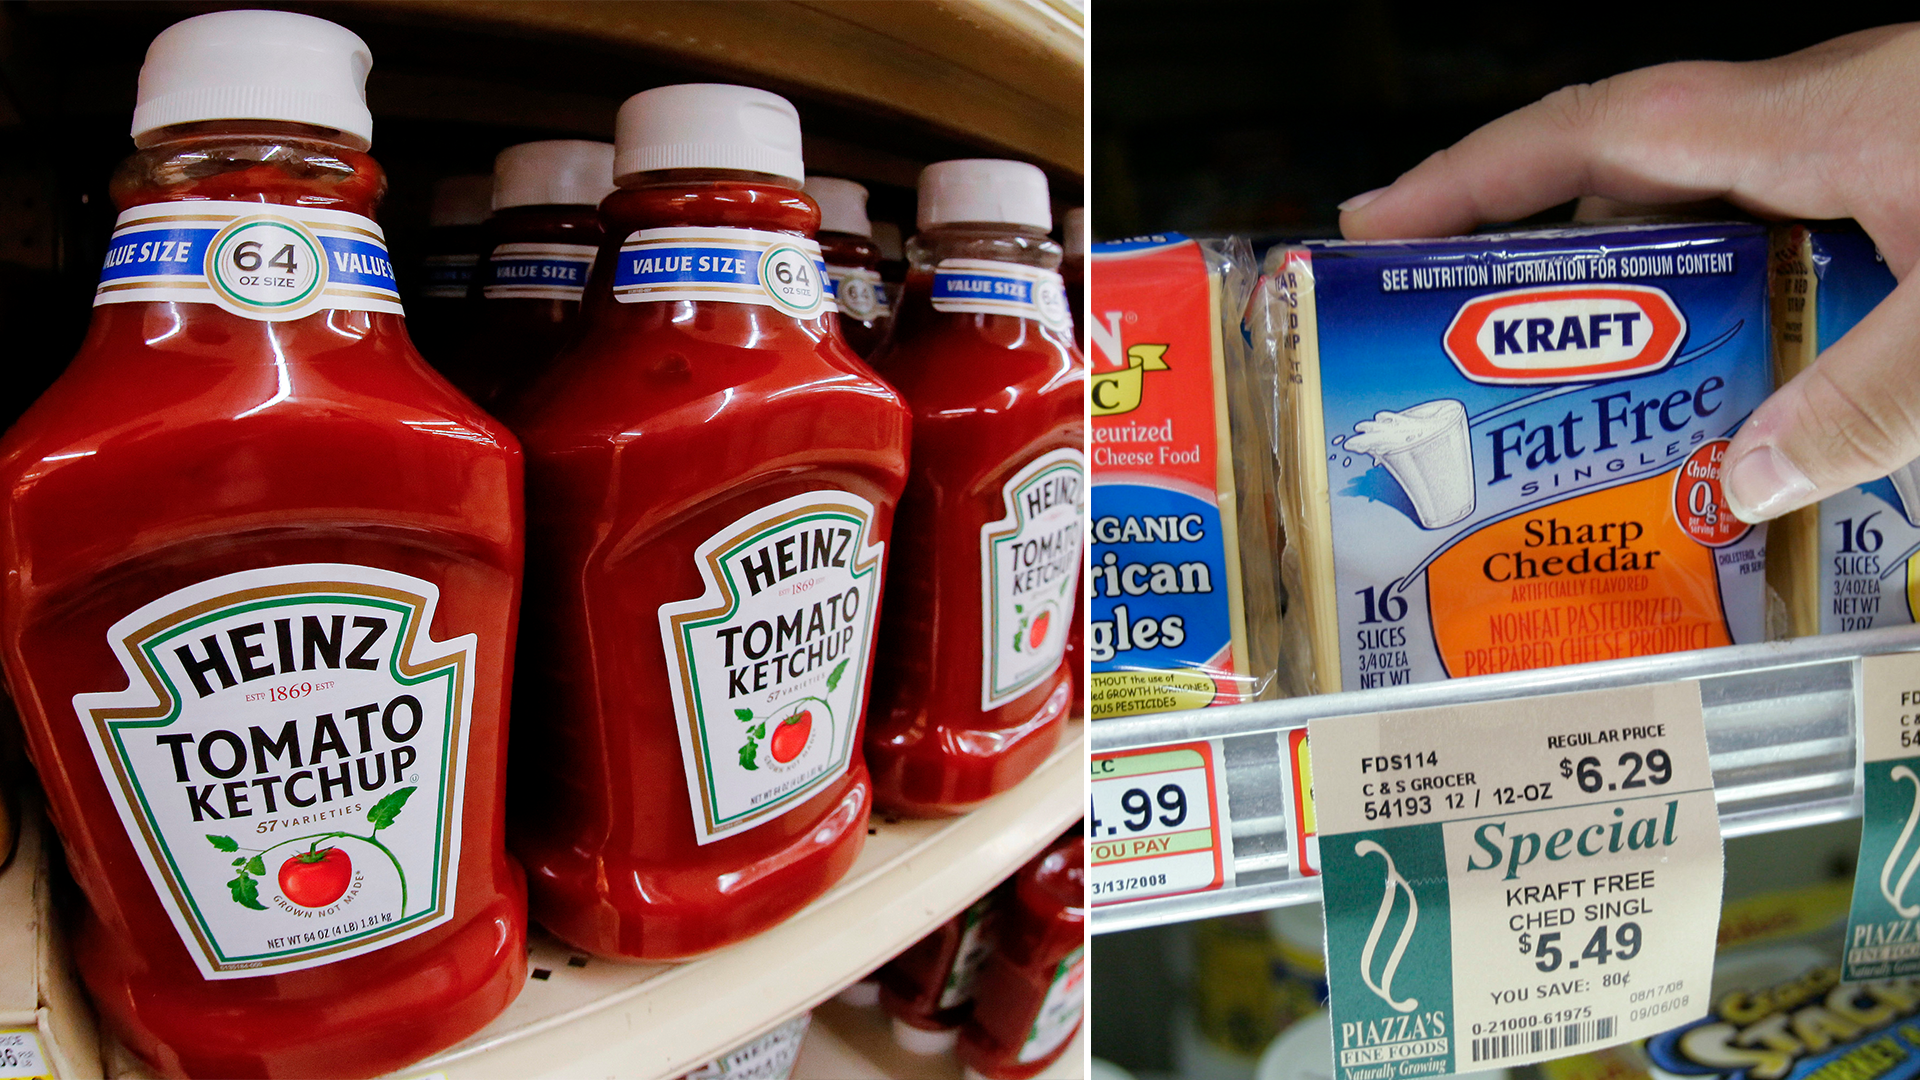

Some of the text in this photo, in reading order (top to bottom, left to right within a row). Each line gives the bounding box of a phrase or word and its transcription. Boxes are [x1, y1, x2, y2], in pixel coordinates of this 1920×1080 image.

[138, 241, 192, 263] SIZE
[233, 241, 298, 274] 64
[333, 251, 388, 278] VALUE
[633, 256, 746, 275] VALUE SIZE
[239, 276, 296, 288] OZ SIZE
[497, 265, 577, 280] VALUE SIZE
[775, 261, 810, 287] 64
[1382, 252, 1734, 291] SEE NUTRITION INFORMATION FOR SODIUM CONTENT
[783, 287, 812, 297] OZ SIZE
[947, 280, 991, 293] VALUE
[994, 281, 1026, 298] SIZE
[1493, 312, 1641, 356] KRAFT
[1486, 375, 1725, 486] Fat Free
[1094, 445, 1200, 466] Cheese Food
[1521, 430, 1705, 497] SINGLES
[1710, 445, 1724, 463] Lo
[1524, 519, 1643, 553] Sharp
[1689, 517, 1699, 528] per
[1690, 526, 1714, 538] serving
[1834, 511, 1883, 554] 16
[740, 528, 852, 597] HEINZ
[1091, 552, 1212, 597] rican
[1482, 548, 1661, 583] Cheddar
[1834, 556, 1880, 576] SLICES
[792, 578, 815, 596] 1869
[1511, 576, 1649, 604] ARTIFICIALLY FLAVORED
[1834, 578, 1852, 596] 3/4
[1354, 577, 1409, 626] 16
[1833, 596, 1881, 615] NET WT
[716, 586, 859, 668] TOMATO
[1489, 597, 1683, 645] NONFAT PASTEURIZED
[1841, 617, 1855, 632] 12
[1357, 626, 1406, 650] SLICES
[1464, 623, 1712, 677] PREPARED CHEESE PRODUCT
[173, 615, 388, 699] HEINZ
[728, 625, 854, 700] KETCHUP
[1358, 652, 1409, 672] 3/4 OZ EA
[268, 682, 313, 702] 1869
[766, 672, 826, 704] 57 VARIETIES
[1106, 687, 1151, 699] GROWTH
[1153, 682, 1210, 695] HORMONES
[1130, 676, 1146, 684] the
[1165, 674, 1174, 682] of
[1360, 668, 1412, 689] NET WT
[1116, 697, 1176, 712] PESTICIDES
[1901, 714, 1910, 727] C
[156, 694, 423, 783] TOMATO
[1547, 723, 1666, 749] REGULAR PRICE
[1361, 751, 1438, 773] FDS114
[1559, 748, 1673, 795] $6.29
[185, 745, 417, 822] KETCHUP
[1362, 772, 1477, 797] C & S GROCER
[1364, 782, 1553, 821] 54193 12 / 12-OZ
[255, 803, 363, 834] 57 VARIETIES
[1133, 837, 1171, 855] PAY
[1467, 800, 1680, 881] Special
[1506, 870, 1656, 907] KRAFT FREE
[273, 895, 313, 918] GROWN
[318, 904, 341, 918] NOT
[1509, 897, 1653, 932] CHED SINGL
[267, 912, 393, 950] NET WT 64 OZ (4 LB) 1.81 kg
[1518, 921, 1643, 973] $5.49
[1491, 970, 1631, 1006] YOU SAVE: 80¢
[1629, 980, 1684, 1004] 08/17/08
[1472, 1005, 1592, 1036] 0-21000-61975
[1629, 995, 1690, 1023] 09/06/08
[1342, 1011, 1445, 1048] PIAZZA'S
[1344, 1040, 1446, 1065] FINE FOODS
[1344, 1058, 1447, 1080] Naturally Growing
